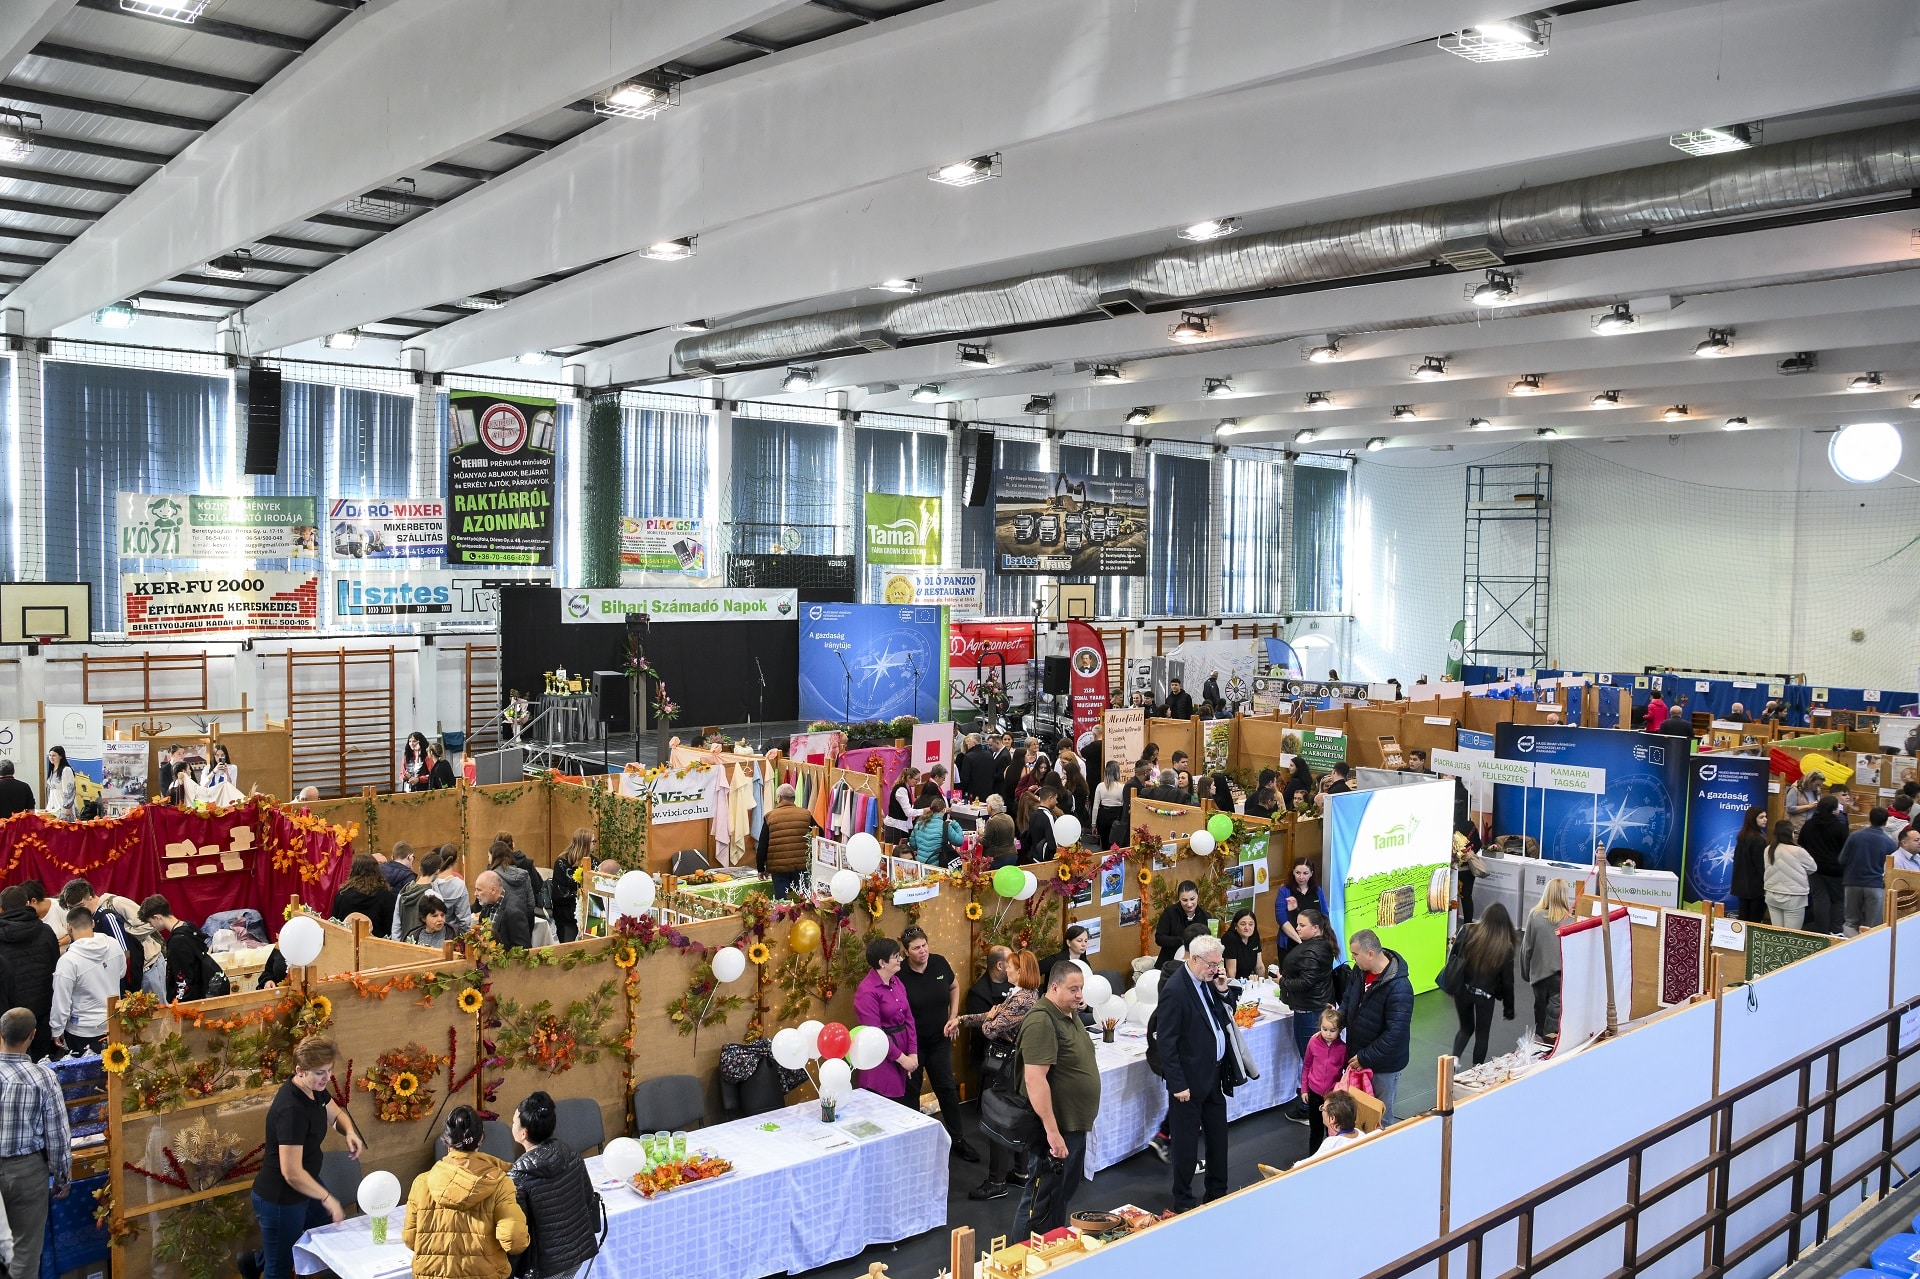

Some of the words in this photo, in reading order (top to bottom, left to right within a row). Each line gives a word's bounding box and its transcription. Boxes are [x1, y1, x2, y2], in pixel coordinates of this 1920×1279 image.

[490, 459, 521, 467] PRÉMIUM
[463, 480, 487, 489] ERKÉLY
[454, 487, 551, 512] RAKTÁRRÓL
[263, 512, 303, 523] IRODÁJA
[462, 511, 545, 533] AZONNAL!
[383, 522, 443, 532] MIXERBETON
[646, 519, 675, 531] PIAC
[675, 520, 701, 532] GSM
[396, 531, 443, 543] SZÁLLÍTÁS
[867, 524, 915, 547] Tama
[1002, 554, 1038, 569] Lisztes
[1037, 555, 1072, 570] Trans
[943, 574, 976, 586] PANZIÓ
[134, 579, 214, 596] KER-FU
[217, 578, 265, 593] 2000
[924, 587, 976, 596] RESTAURANT
[337, 579, 450, 616] Lisztes
[227, 600, 298, 613] KERESKEDÉS
[601, 599, 648, 615] Bihari
[651, 598, 720, 613] Számadó
[723, 598, 768, 615] Napok
[279, 618, 310, 627] 500-105
[815, 631, 846, 641] gazdaság
[823, 641, 852, 650] iránytűje
[965, 636, 1023, 655] Agrconnect
[1314, 735, 1333, 743] BIHAR
[1433, 757, 1454, 768] PIACRA
[1454, 760, 1472, 771] JUTÁS
[1477, 759, 1531, 774] VÁLLALKOZÁS-
[1482, 770, 1525, 784] FEJLESZTÉS
[1550, 767, 1591, 779] KAMARAI
[1553, 777, 1587, 789] TAGSÁG
[658, 788, 705, 805] Vixi
[1698, 790, 1706, 798] A
[1707, 791, 1749, 802] gazdaság
[1373, 833, 1405, 850] Tama
[1606, 884, 1672, 898] hbkik@hbkik.hu
